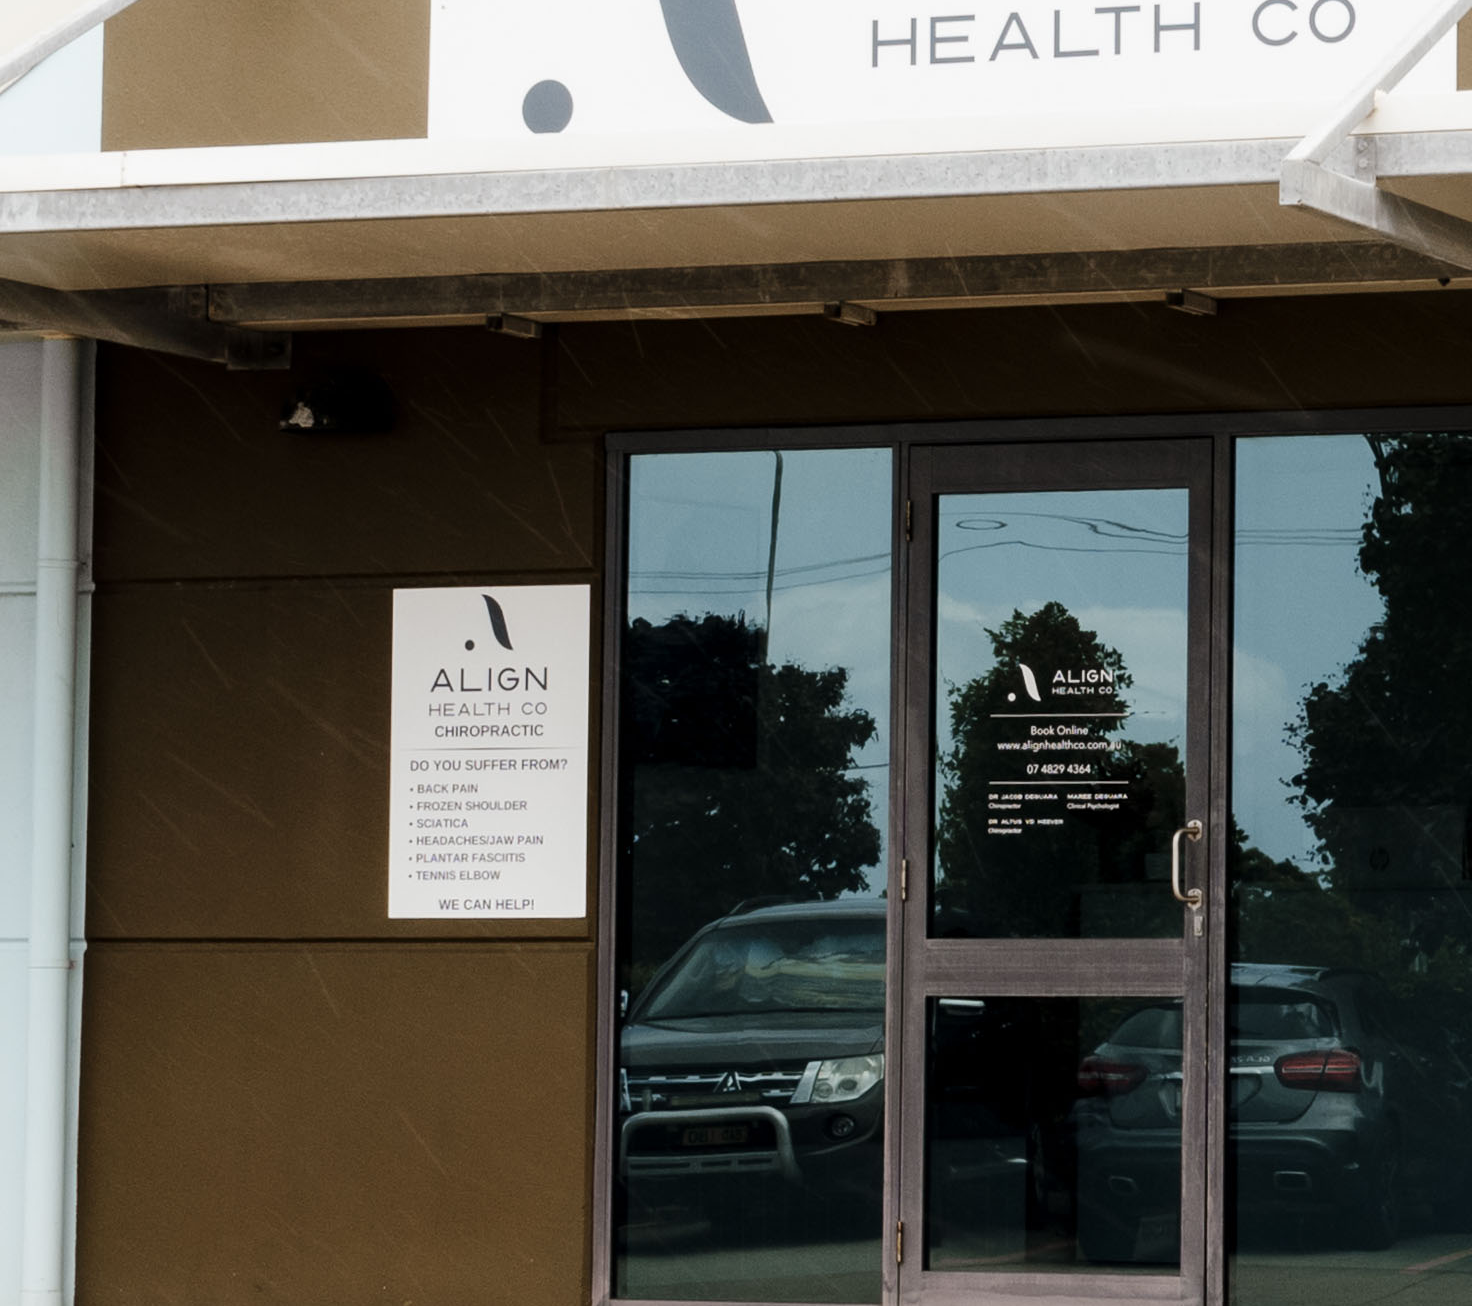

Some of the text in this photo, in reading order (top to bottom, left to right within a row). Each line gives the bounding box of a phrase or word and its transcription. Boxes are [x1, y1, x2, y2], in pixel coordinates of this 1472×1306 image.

[872, 1, 1201, 67] HEALTH
[430, 667, 548, 692] ALIGN
[1052, 670, 1113, 684] ALIGN
[1052, 686, 1113, 694] HEALTH CO
[429, 701, 547, 716] HEALTH CO
[434, 724, 544, 738] CHIROPRACTIC
[1031, 725, 1088, 736] Book Online
[997, 740, 1121, 752] www.alignhealthco.com.au
[410, 758, 567, 771] DO YOU SUFFER FROM?
[1026, 764, 1091, 774] 07 4829 4364
[417, 784, 478, 794] BACK PAIN
[417, 801, 527, 811] FROZEN SHOULDER
[417, 819, 468, 828] SCIATICA
[416, 835, 544, 845] HEADACHES/JAW PAIN
[416, 854, 468, 863] PLANTAR
[416, 871, 500, 880] TENNIS ELBOW
[439, 899, 535, 910] WE CAN HELP!
